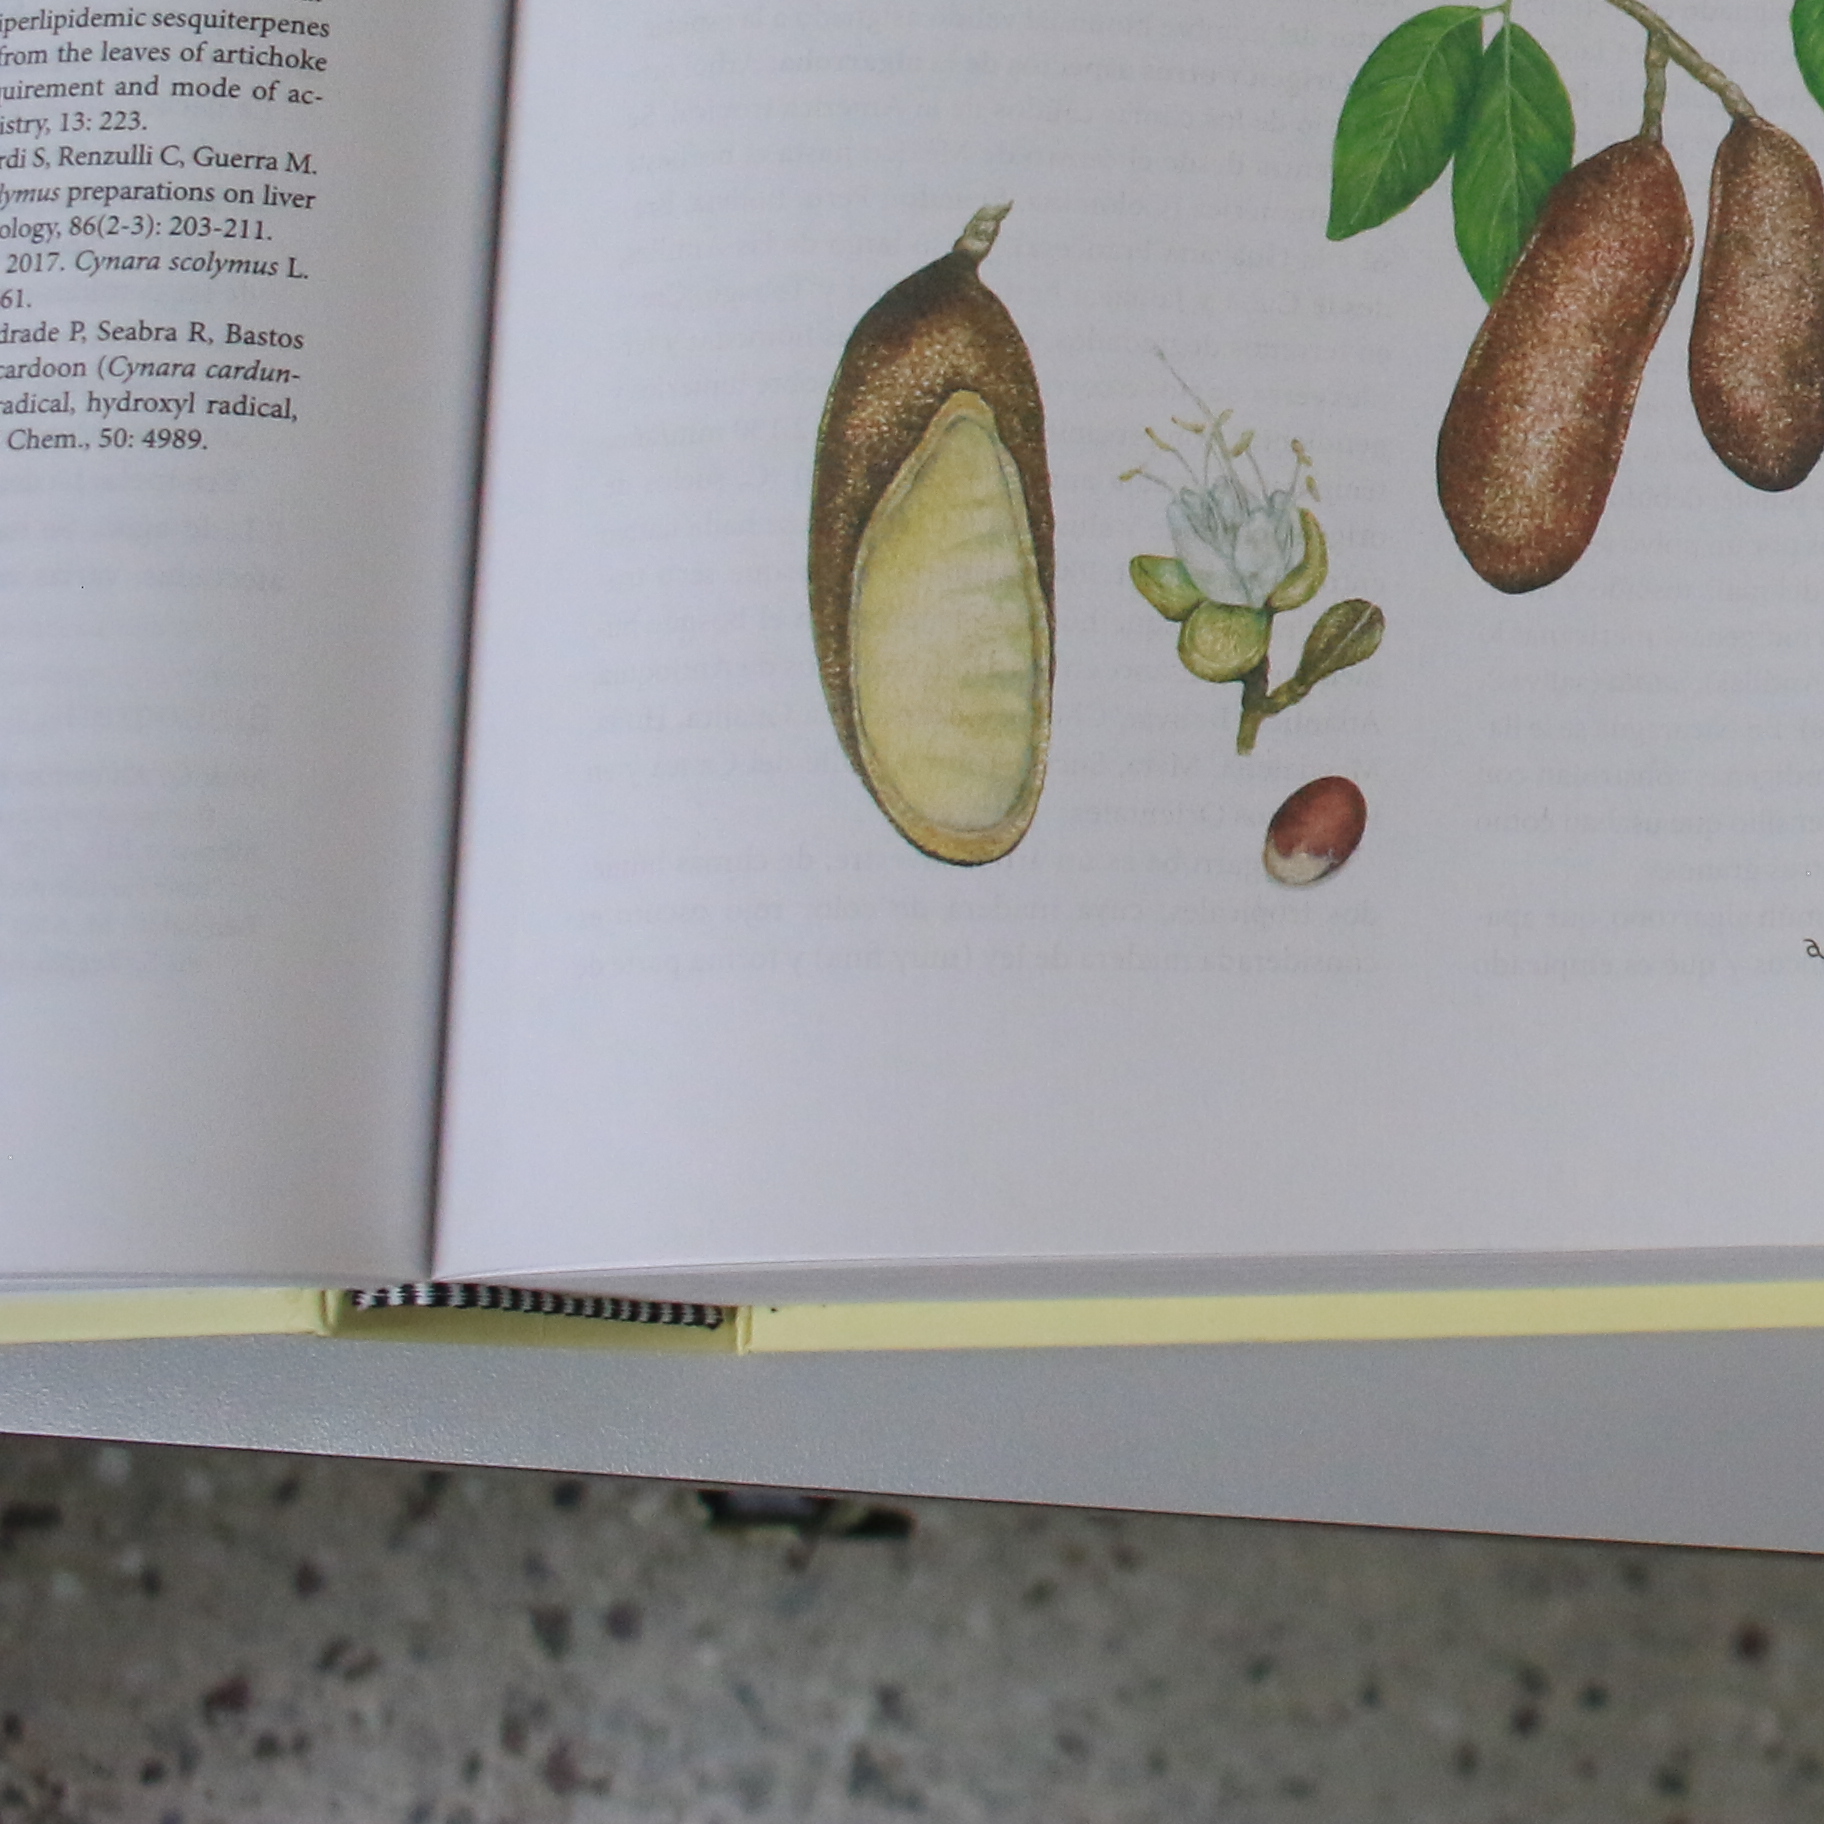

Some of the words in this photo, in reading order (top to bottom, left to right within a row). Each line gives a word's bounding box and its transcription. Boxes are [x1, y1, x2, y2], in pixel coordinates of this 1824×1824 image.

[151, 9, 331, 39] sesquiterpenes
[56, 41, 94, 64] the
[100, 40, 171, 63] leaves
[179, 40, 209, 63] of
[211, 44, 328, 73] artichoke
[66, 180, 217, 209] preparations
[222, 187, 255, 205] on
[262, 183, 317, 210] liver
[5, 250, 65, 275] 2017.
[74, 249, 162, 278] Cynara
[168, 249, 280, 280] scolymus
[286, 256, 309, 280] L.
[6, 427, 91, 452] Chem.,
[98, 427, 135, 449] 50:
[141, 427, 208, 451] 4989.
